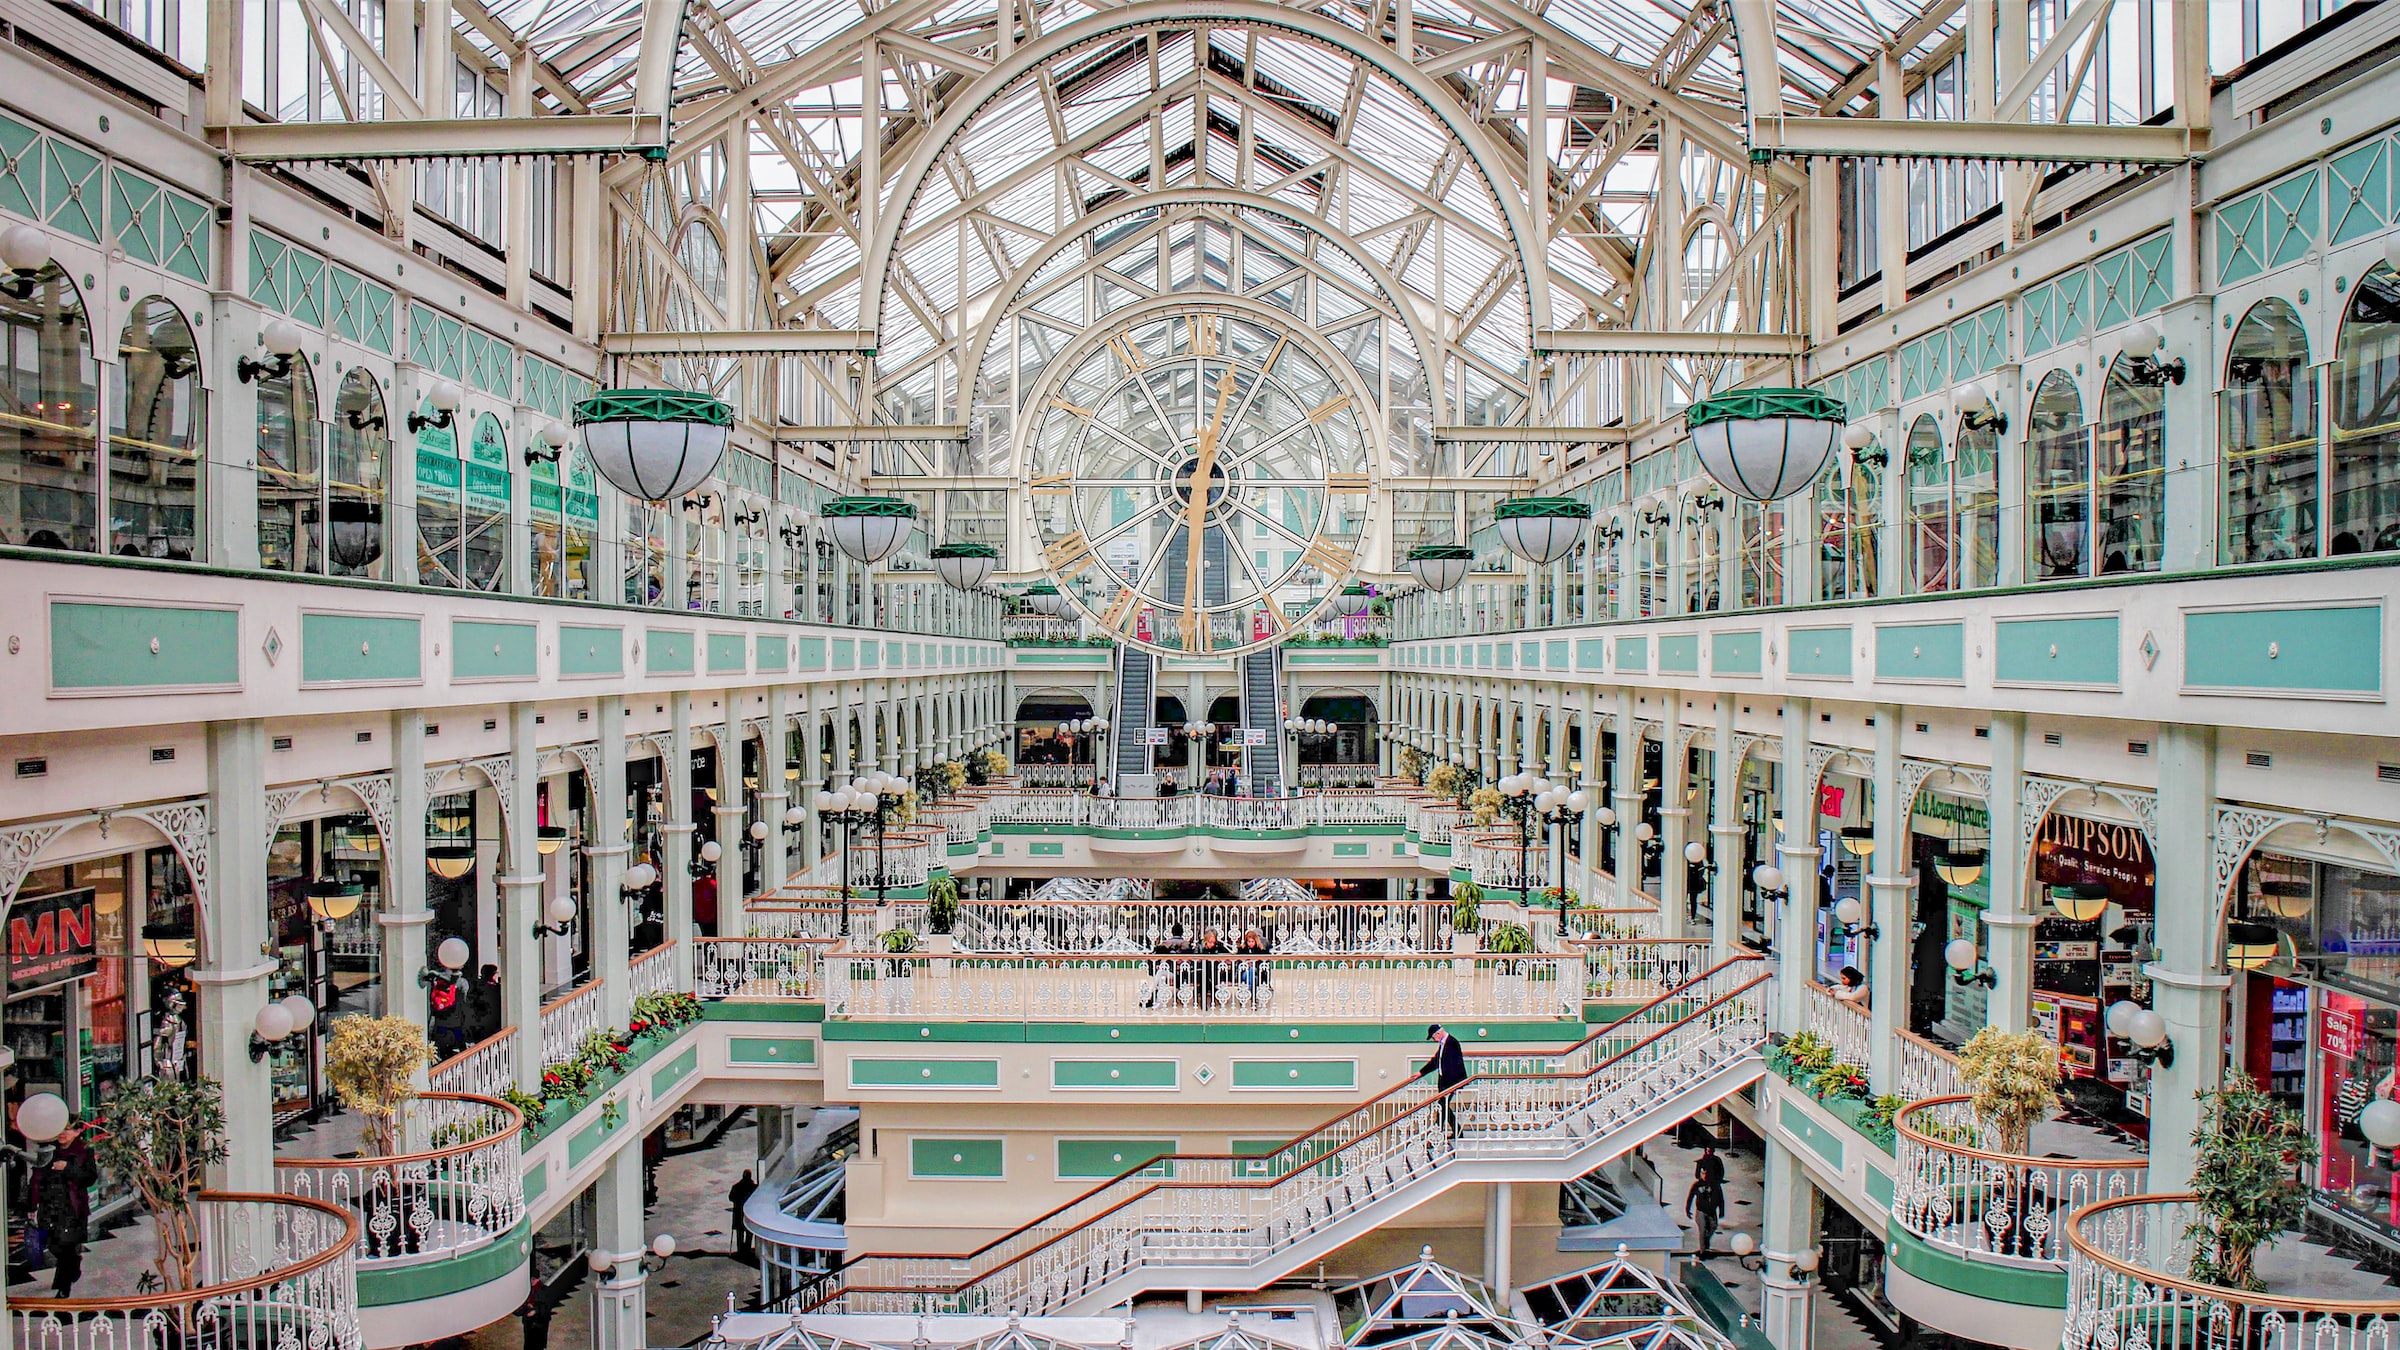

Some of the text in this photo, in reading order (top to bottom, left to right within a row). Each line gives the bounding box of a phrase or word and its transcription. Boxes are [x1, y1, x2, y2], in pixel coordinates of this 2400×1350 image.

[1928, 793, 1988, 829] Acupuncture
[2042, 811, 2144, 864] TIMPSON
[2083, 859, 2112, 877] Service
[11, 903, 92, 965] MN
[12, 953, 93, 981] MODERN NUTRITION
[2326, 1016, 2349, 1034] Sale
[2326, 1033, 2348, 1051] 70%
